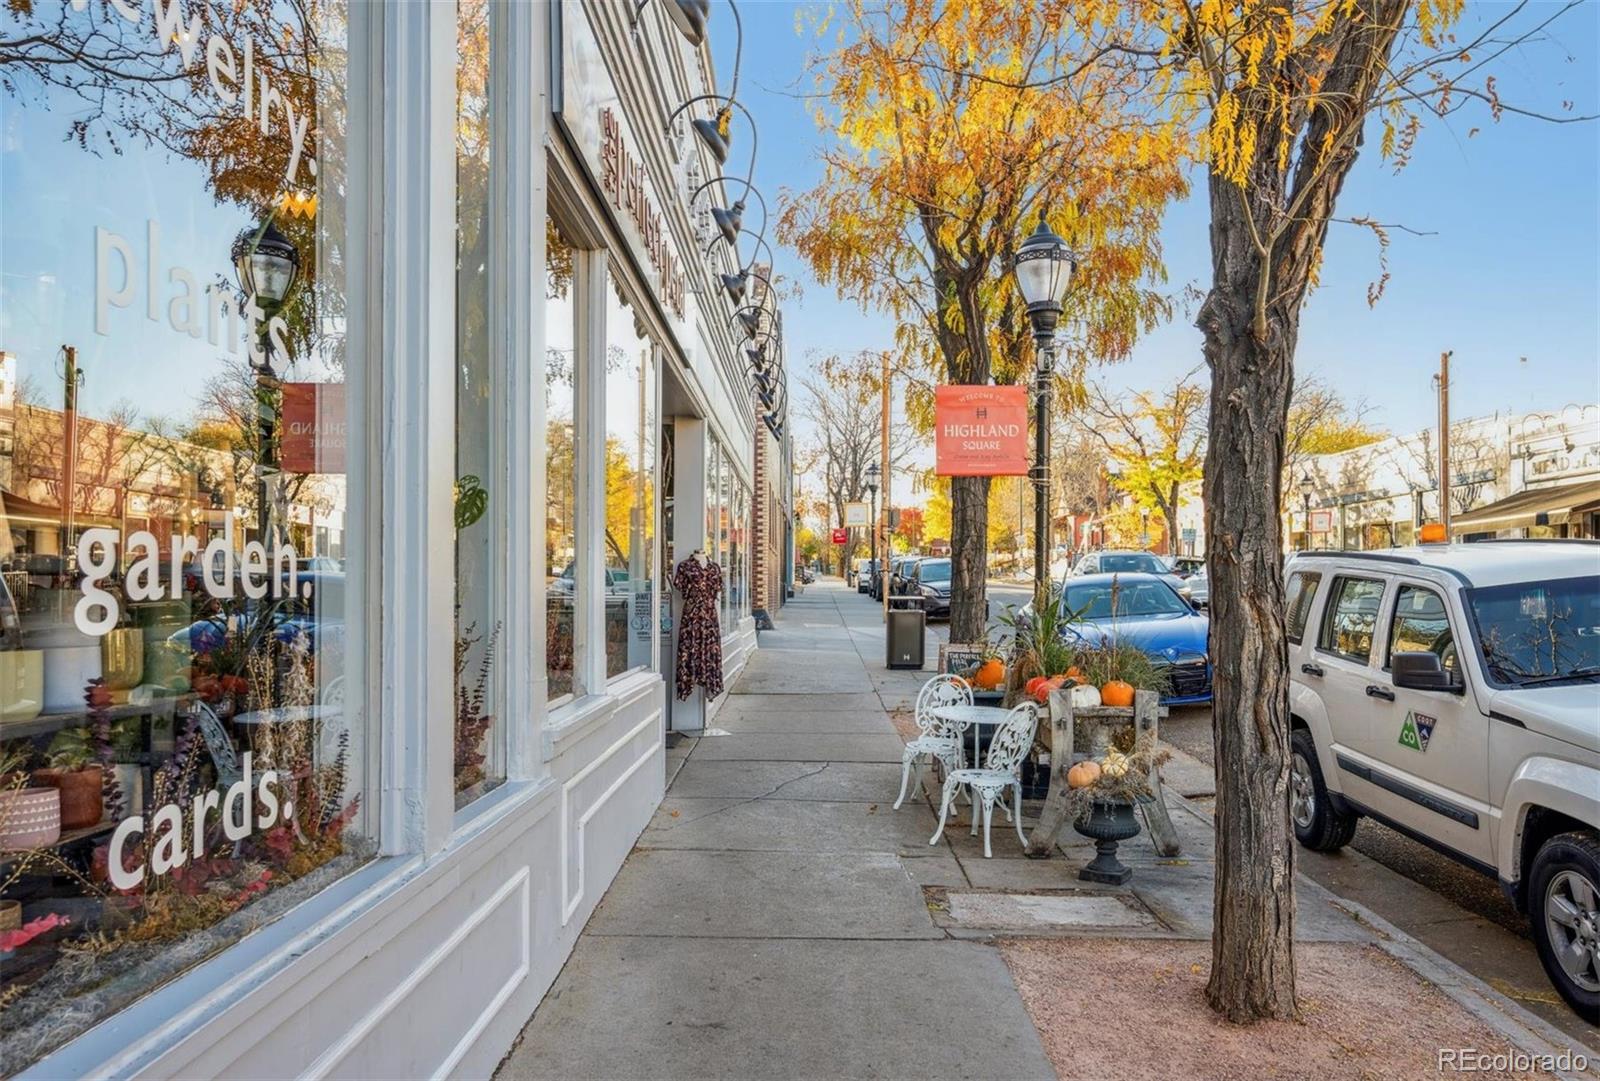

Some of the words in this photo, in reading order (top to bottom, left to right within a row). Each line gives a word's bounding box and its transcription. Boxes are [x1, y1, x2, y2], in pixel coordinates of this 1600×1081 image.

[93, 217, 291, 373] plants
[943, 424, 1020, 438] HIGHLAND
[962, 440, 1001, 450] SQUARE
[73, 511, 313, 637] garden.
[1403, 730, 1415, 744] CO
[108, 750, 293, 891] cards.
